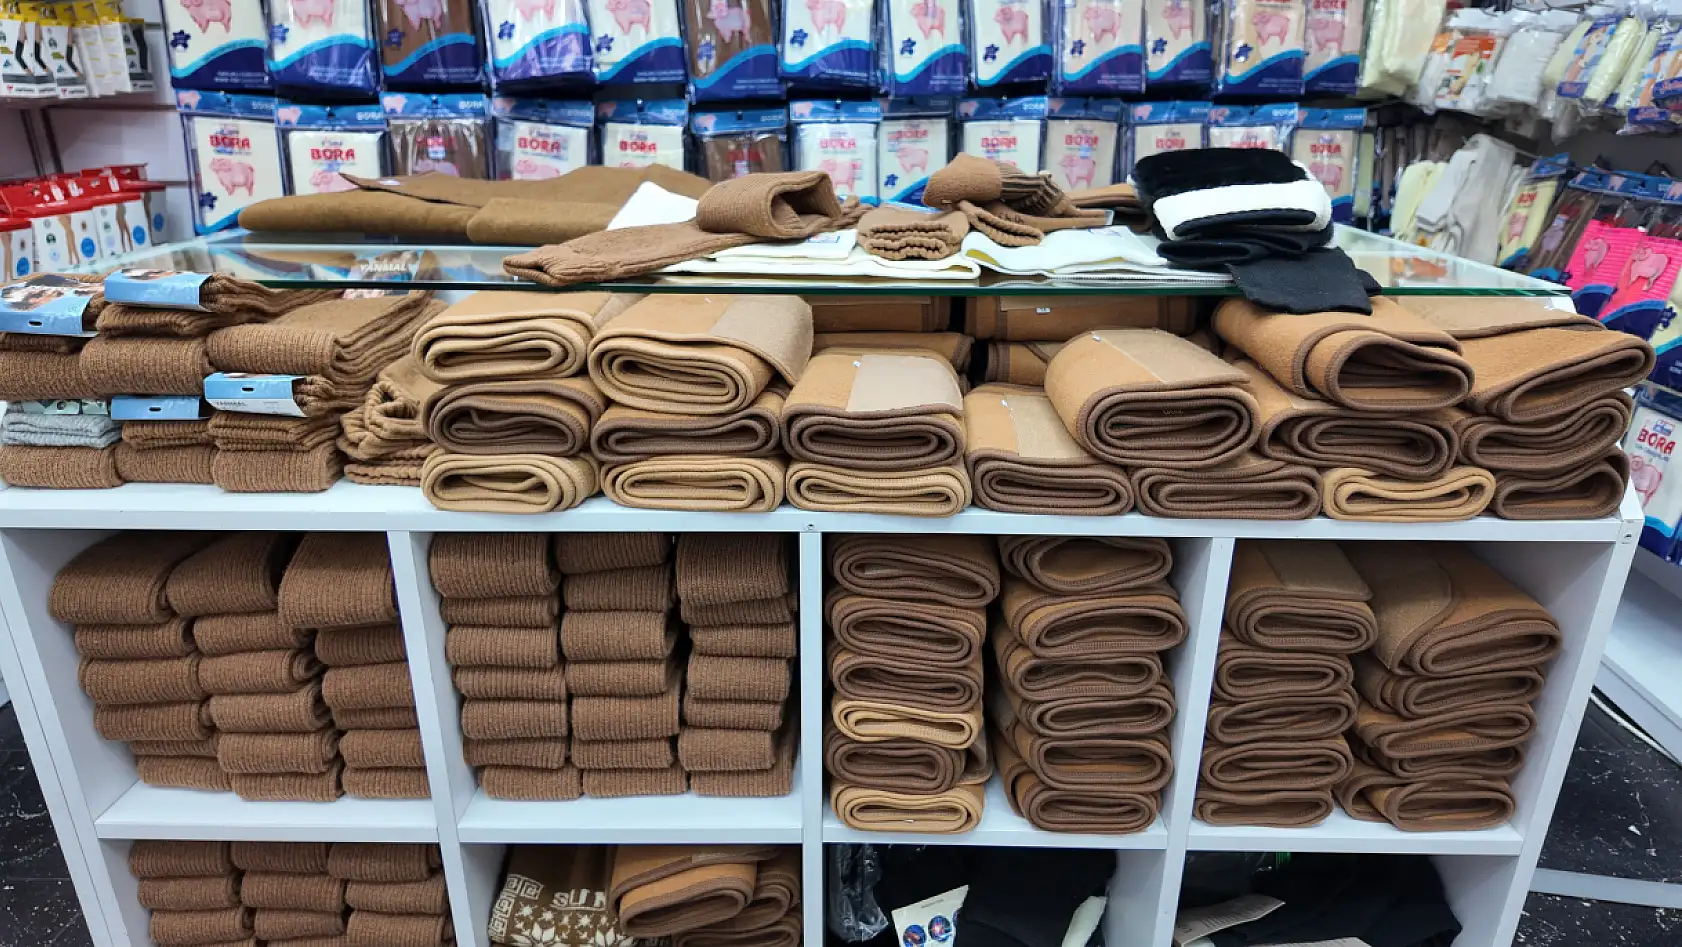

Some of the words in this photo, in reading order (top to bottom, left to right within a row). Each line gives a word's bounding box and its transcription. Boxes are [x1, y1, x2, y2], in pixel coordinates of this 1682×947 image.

[208, 134, 251, 149] BORA
[517, 137, 562, 153] BORA
[619, 140, 657, 153] BORA
[310, 148, 356, 161] BORA
[1637, 427, 1676, 455] BORA
